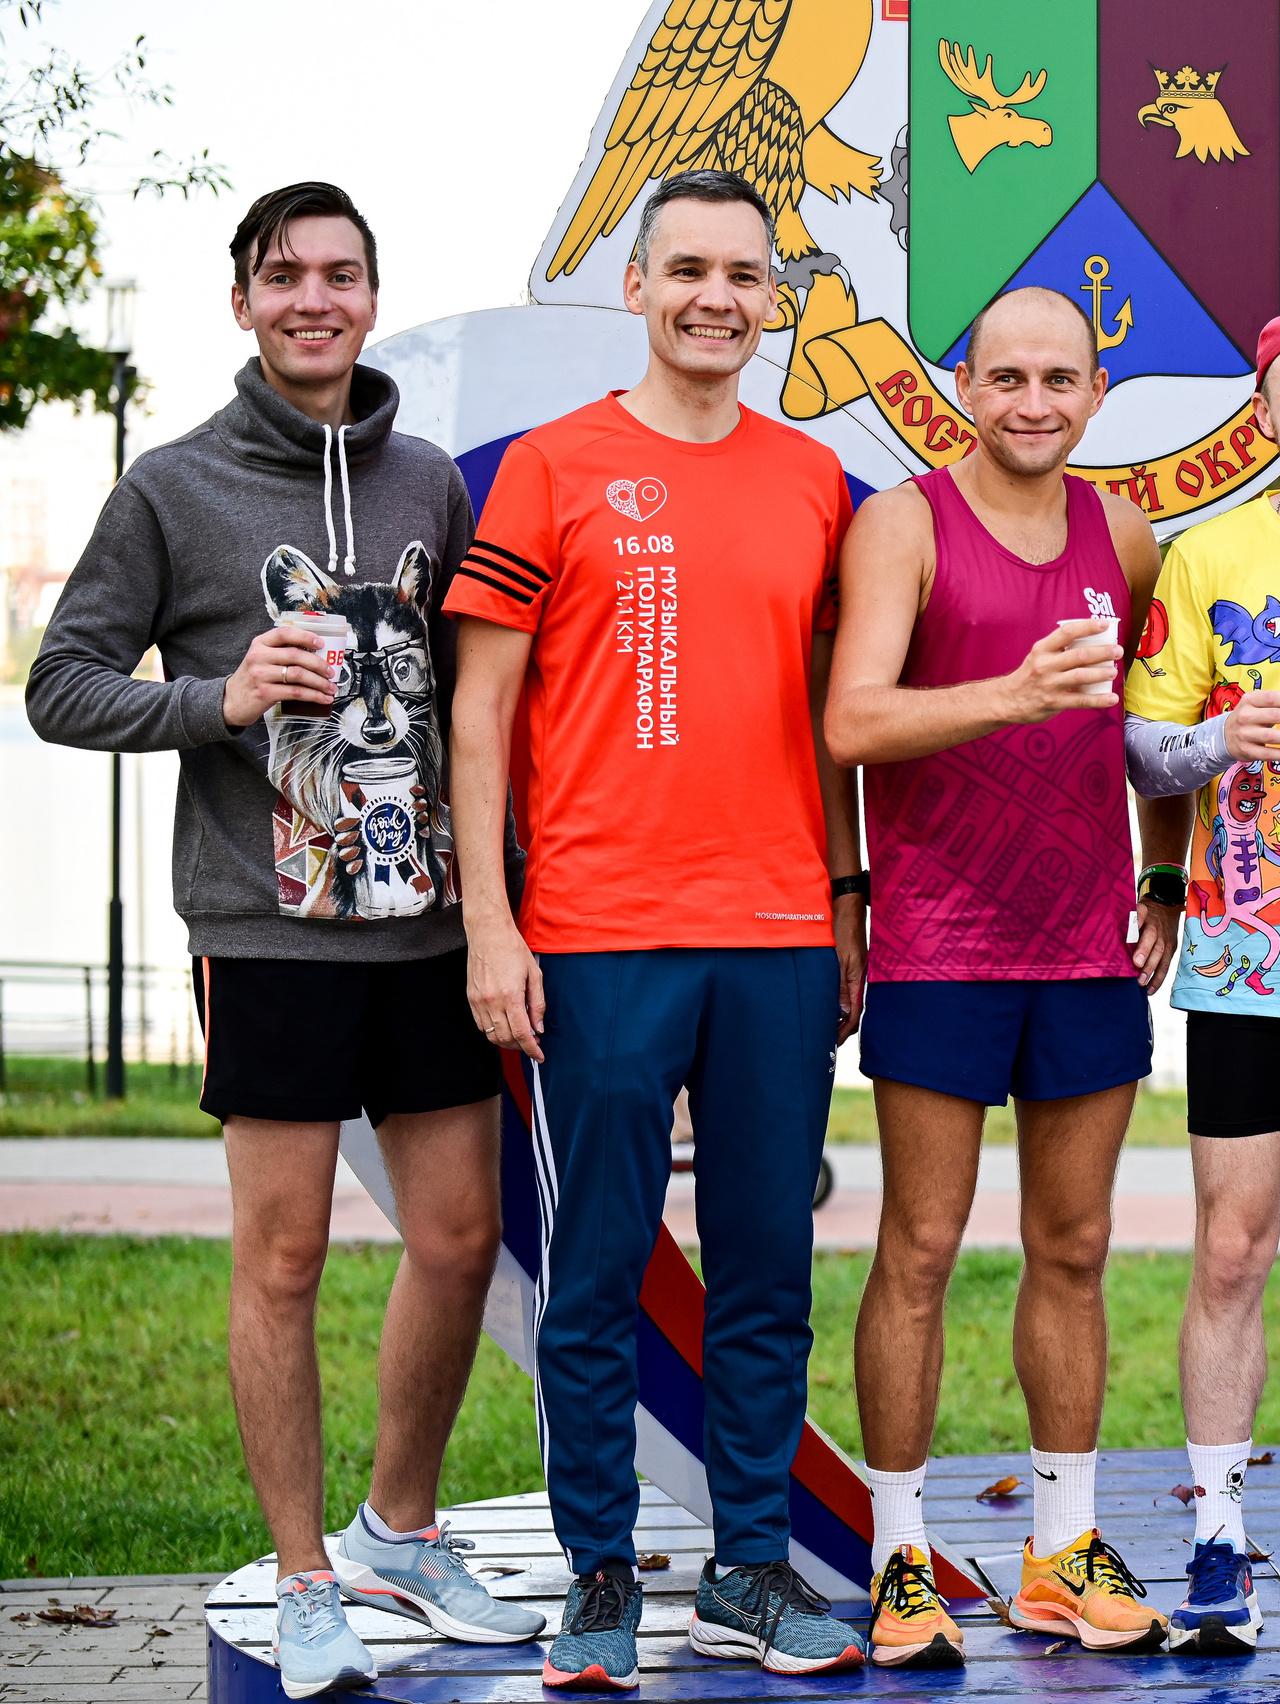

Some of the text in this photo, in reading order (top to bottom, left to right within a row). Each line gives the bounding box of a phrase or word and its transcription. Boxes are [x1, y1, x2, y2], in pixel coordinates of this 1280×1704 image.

[613, 535, 675, 556] 16.08
[616, 620, 635, 653] КМ
[636, 566, 654, 749] ПОЛУМАРАФОН
[660, 566, 680, 746] МУЗЫКАЛЬНЫЙ
[754, 911, 825, 921] MOSCOWMARATHON.ORG
